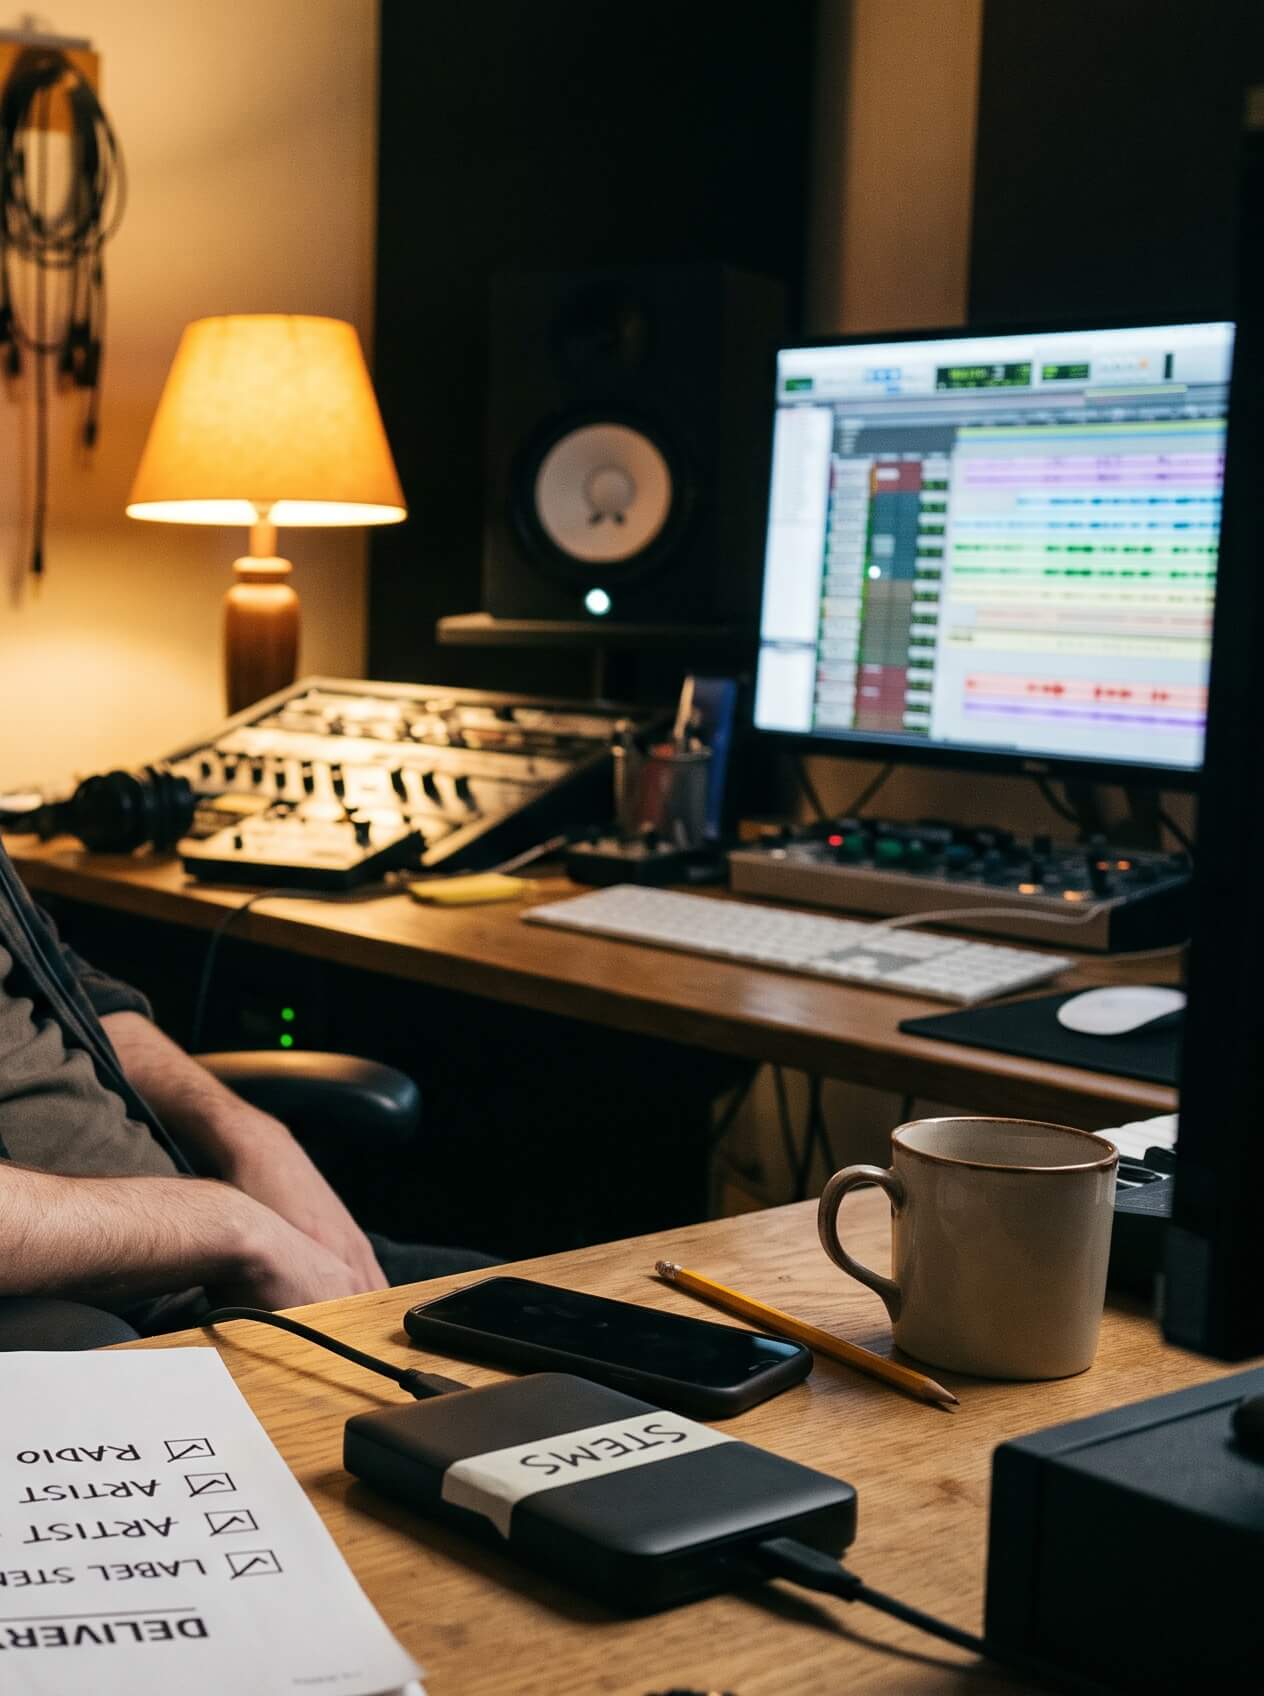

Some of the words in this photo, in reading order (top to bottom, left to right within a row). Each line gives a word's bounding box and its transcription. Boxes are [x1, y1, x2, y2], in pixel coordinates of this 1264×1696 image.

[16, 1444, 141, 1465] RADIO
[519, 1423, 687, 1477] STEMS
[18, 1479, 161, 1504] ARTIST
[23, 1516, 179, 1544] ARTIST
[89, 1559, 207, 1581] LABEL
